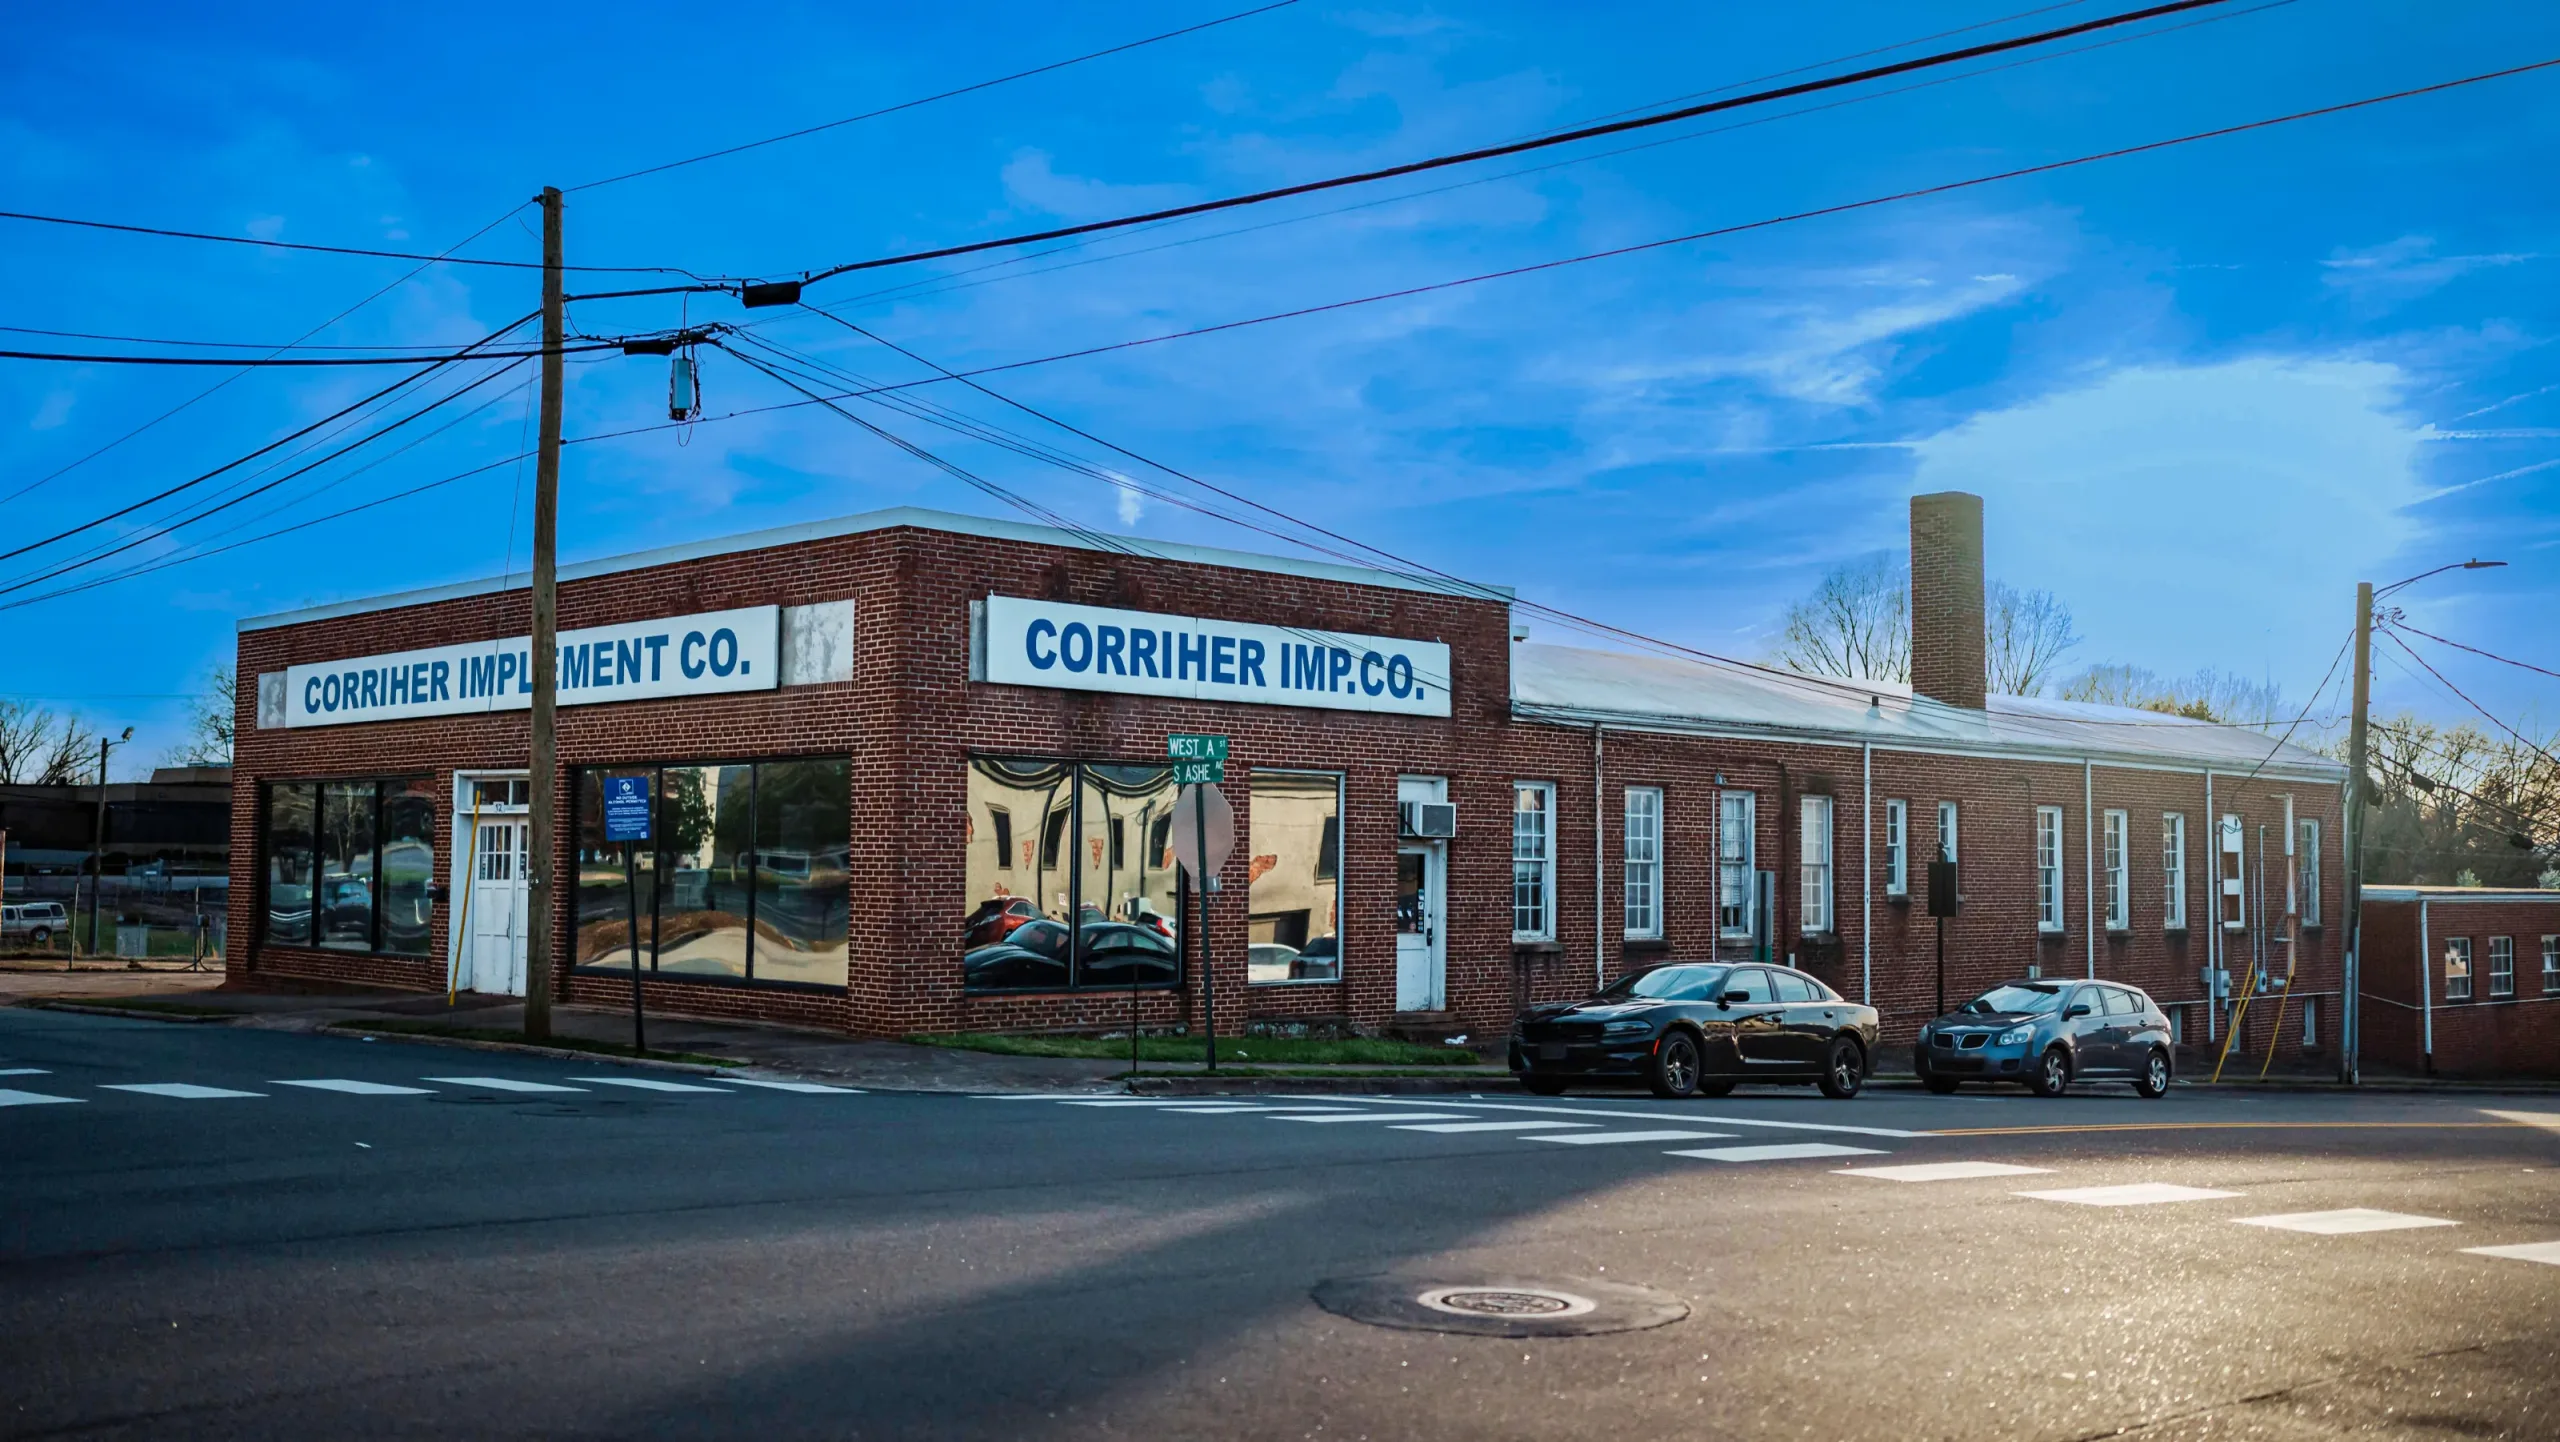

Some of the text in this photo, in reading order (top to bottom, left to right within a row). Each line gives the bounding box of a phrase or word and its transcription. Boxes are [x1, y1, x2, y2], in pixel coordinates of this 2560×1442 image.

[305, 627, 750, 714] CORRIHER IMPLMENT CO.
[1026, 618, 1267, 687] CORRIHER
[1169, 738, 1199, 756] WEST
[1206, 739, 1214, 756] A
[1173, 765, 1180, 781] S
[1185, 764, 1211, 781] ASHE
